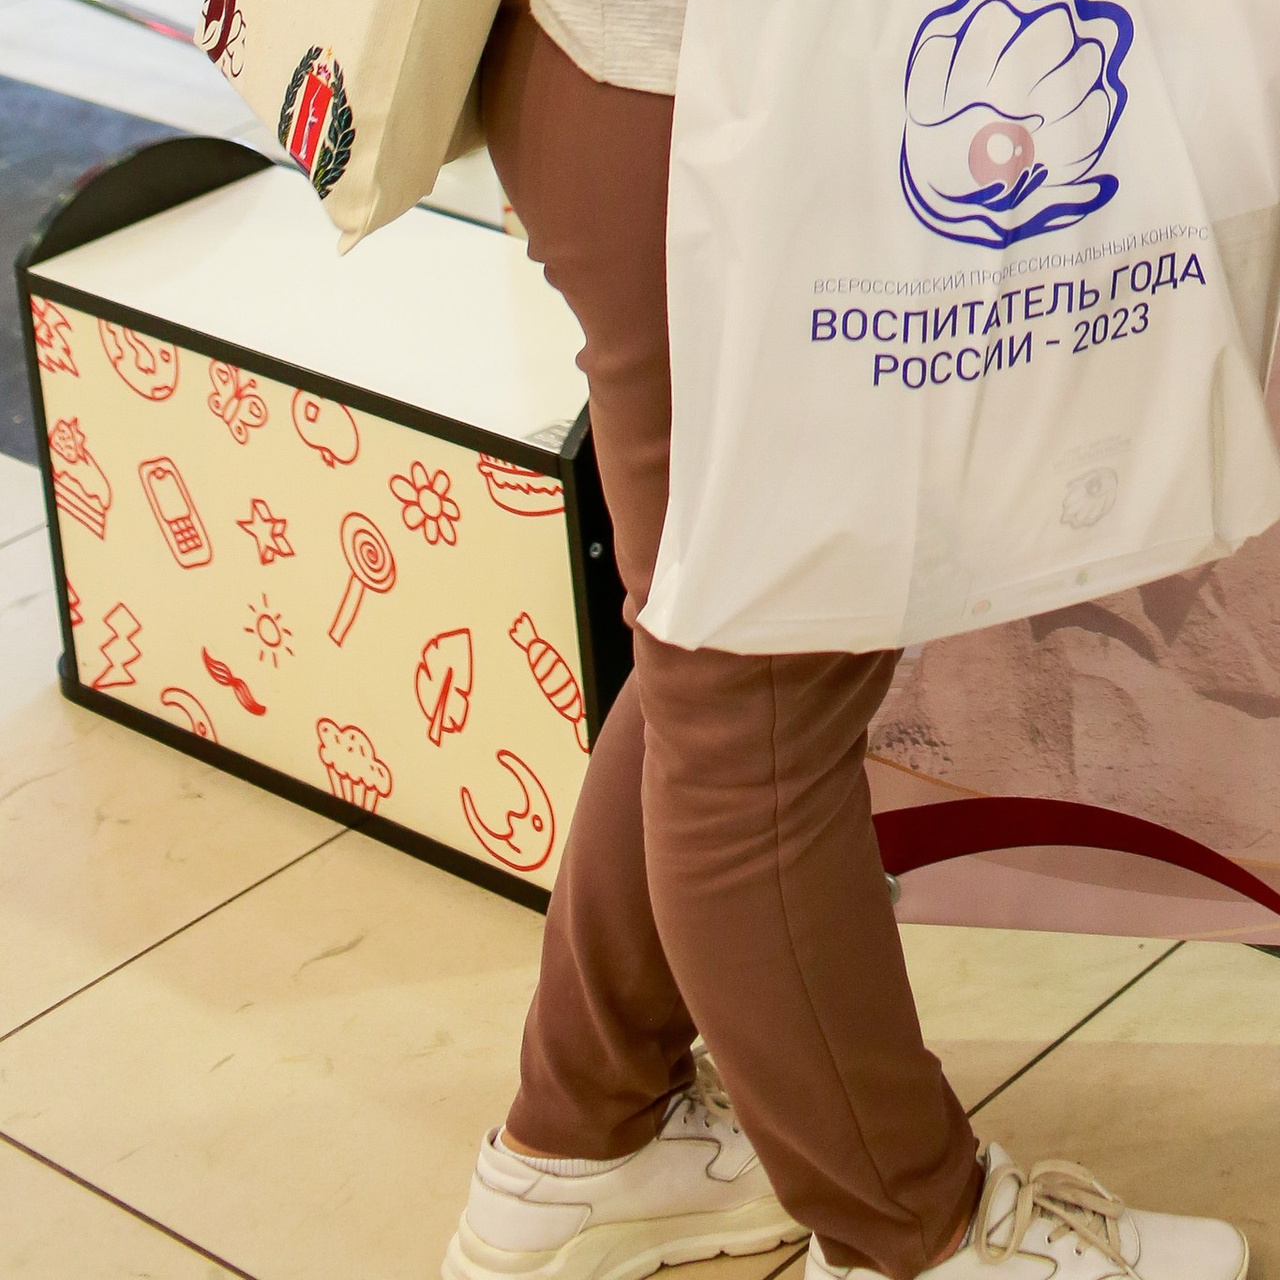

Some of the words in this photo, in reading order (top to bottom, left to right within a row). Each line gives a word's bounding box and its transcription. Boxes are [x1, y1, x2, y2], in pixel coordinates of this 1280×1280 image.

[811, 280, 1101, 342] ВОСПИТАТЕЛЬ
[1110, 253, 1207, 301] ГОДА
[813, 270, 965, 297] ВСЕРОССИЙСКИЙ
[1139, 224, 1209, 249] КОНКУРС
[873, 331, 1032, 389] РОССИИ
[1072, 302, 1150, 354] 2023
